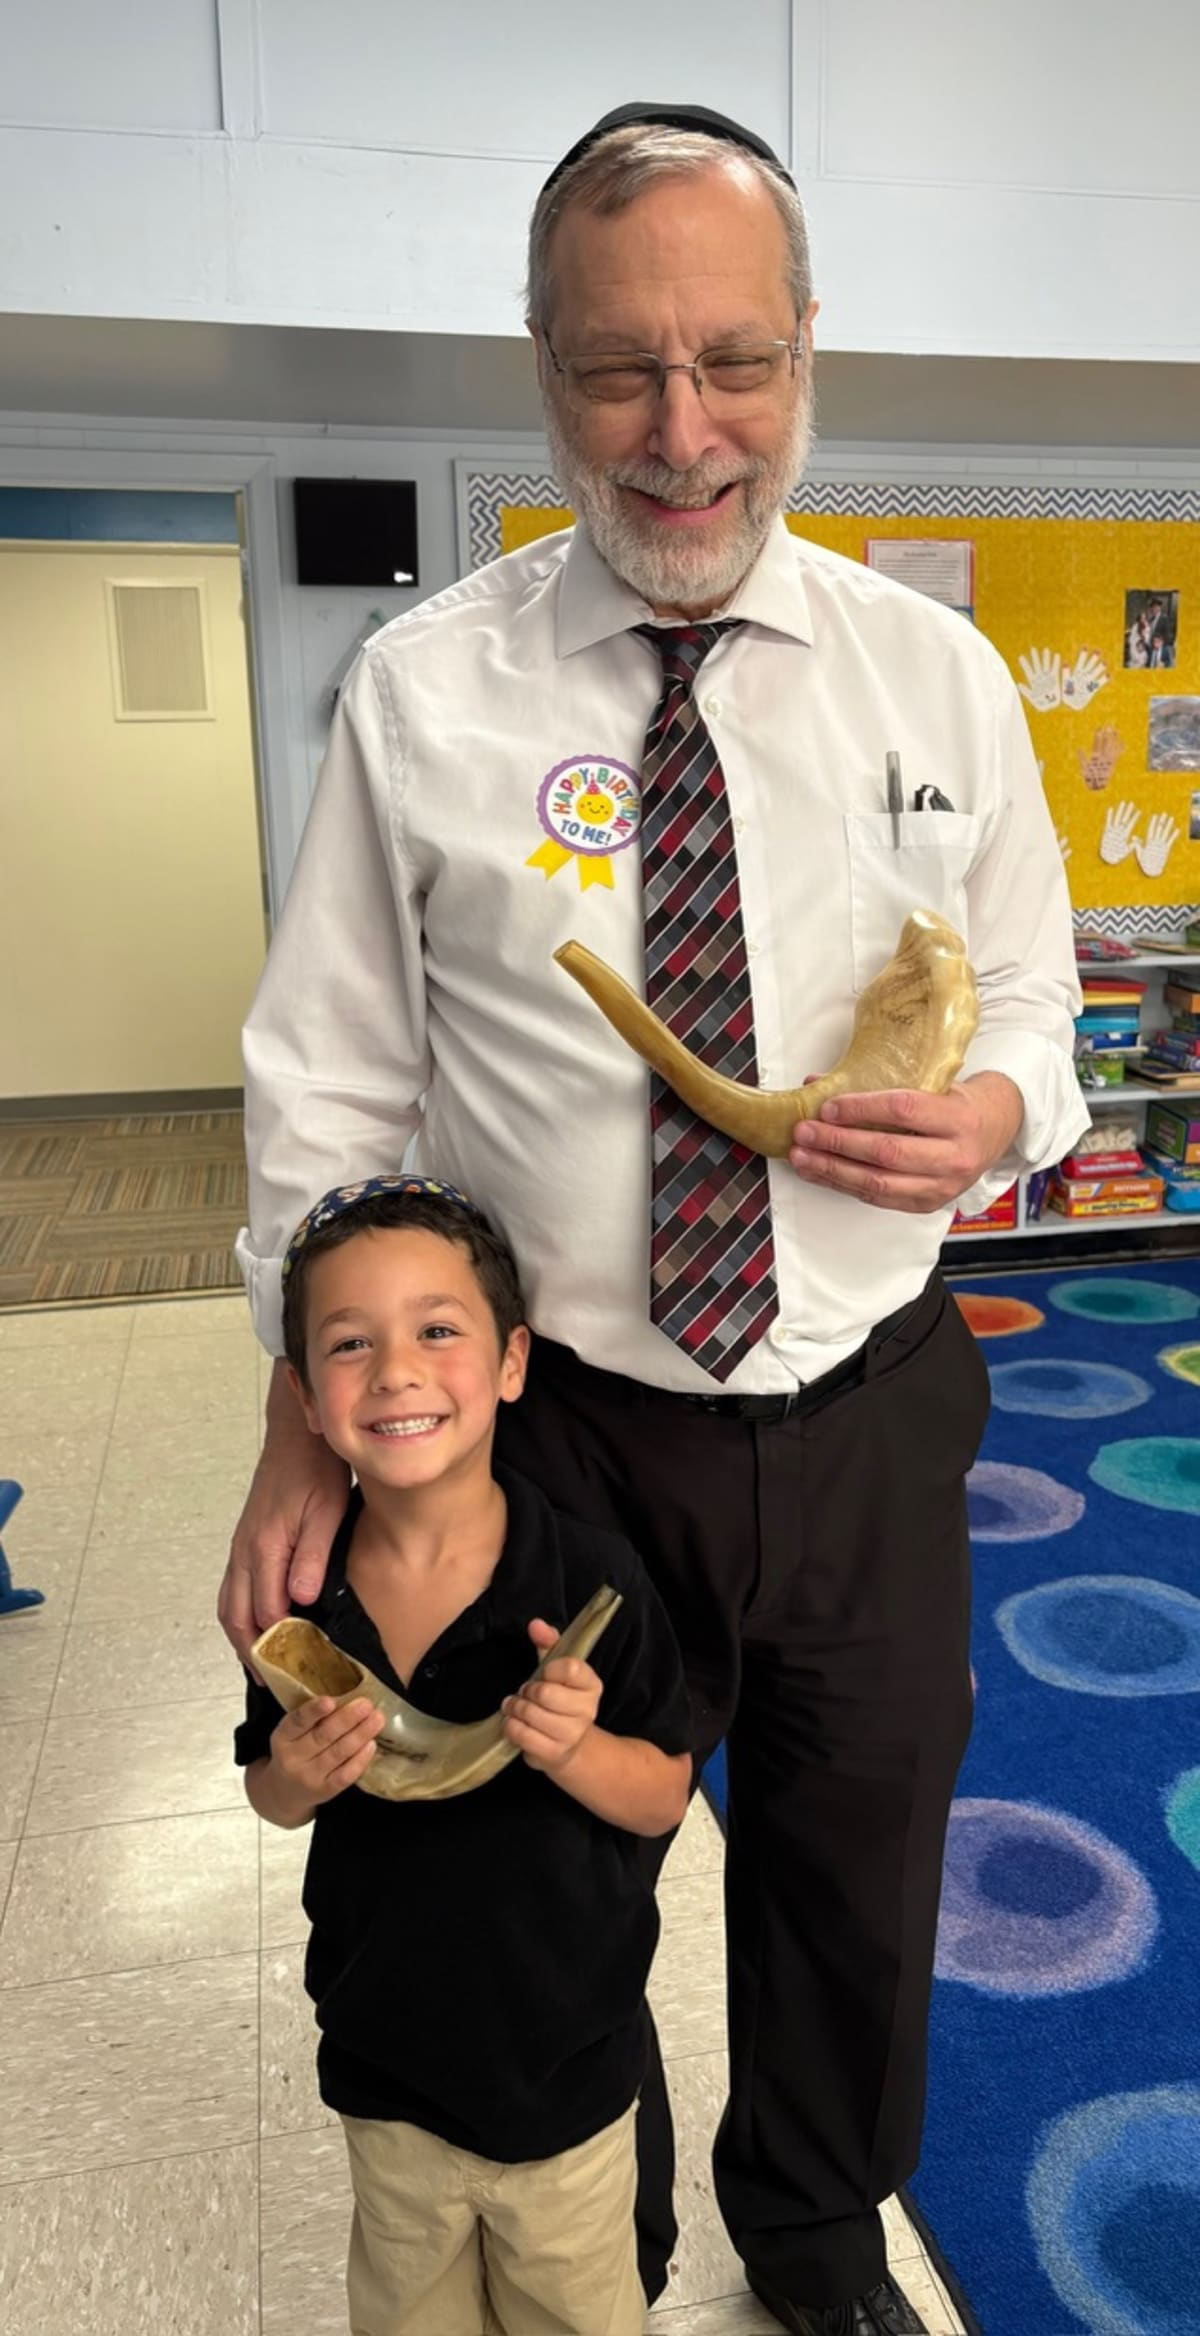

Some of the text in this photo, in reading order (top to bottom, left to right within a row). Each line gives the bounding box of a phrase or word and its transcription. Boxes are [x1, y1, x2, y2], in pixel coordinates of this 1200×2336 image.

[552, 767, 640, 837] HAPPY BIRTHDAY
[560, 819, 612, 846] TO ME!
